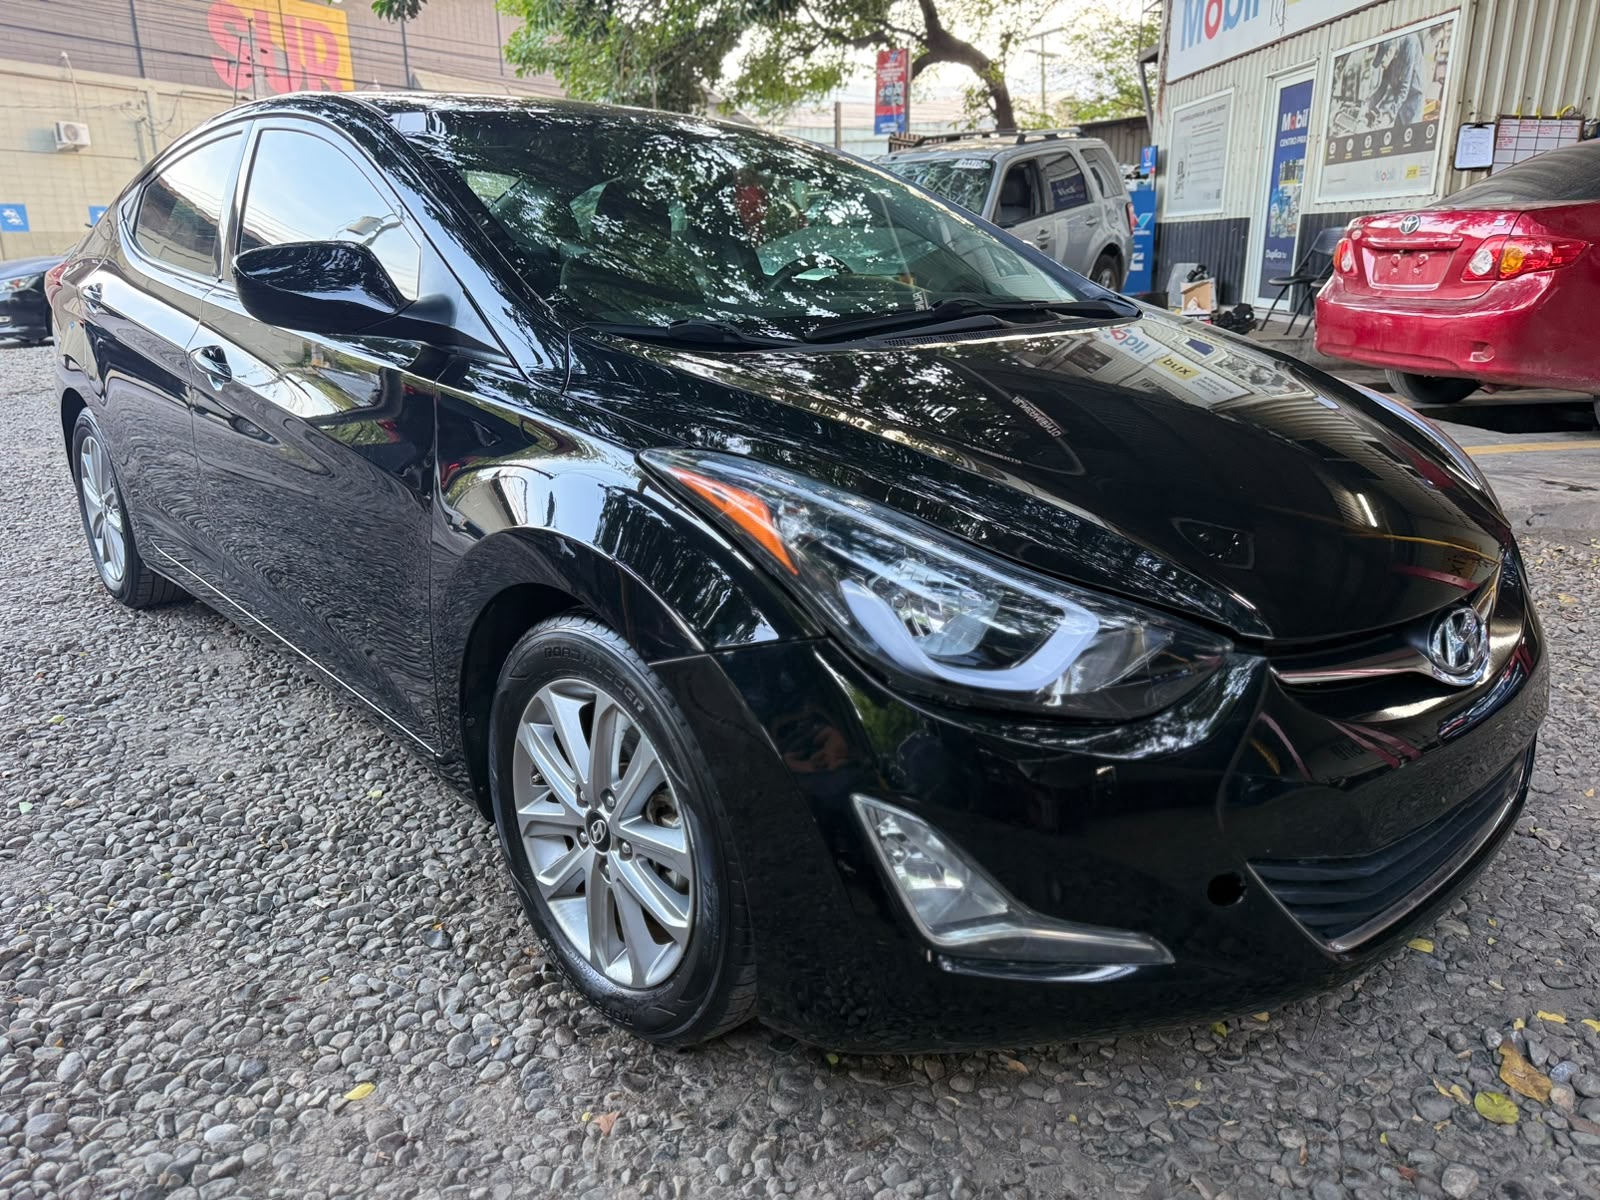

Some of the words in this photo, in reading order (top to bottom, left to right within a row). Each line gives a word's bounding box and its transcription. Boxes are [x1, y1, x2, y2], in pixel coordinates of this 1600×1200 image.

[207, 0, 344, 93] SUR
[1281, 108, 1309, 132] Mobil
[544, 646, 580, 661] ROAD
